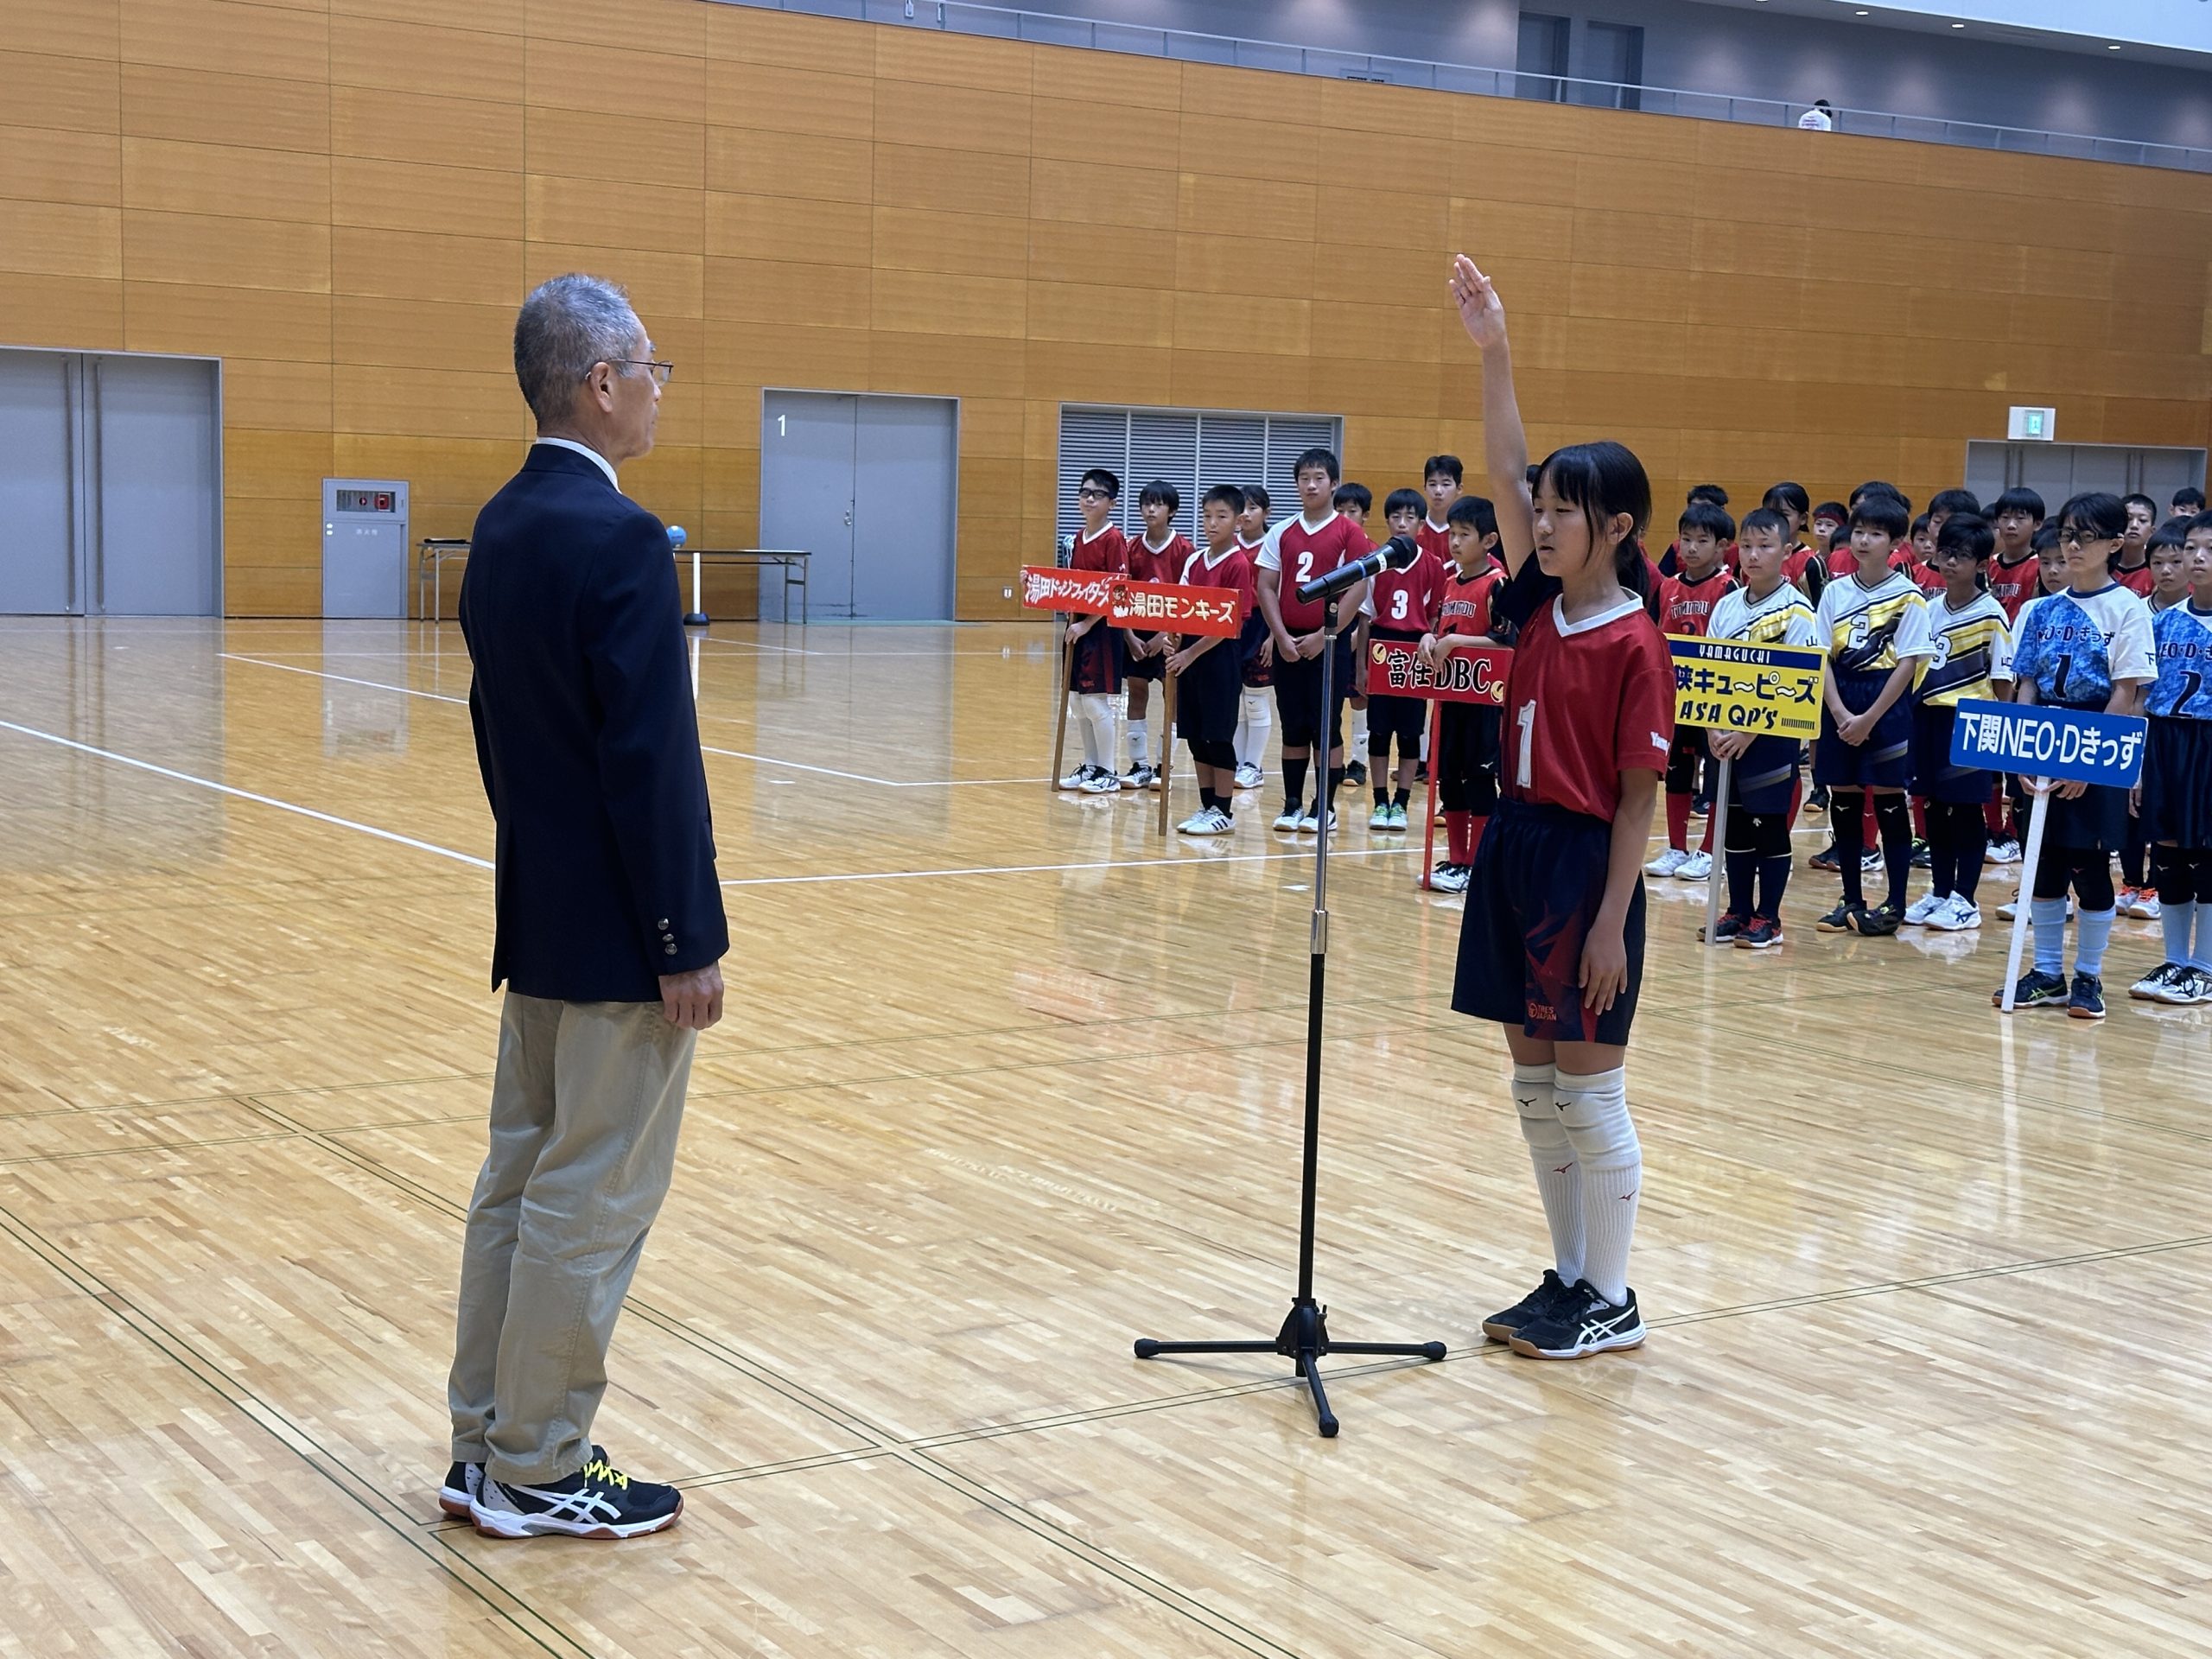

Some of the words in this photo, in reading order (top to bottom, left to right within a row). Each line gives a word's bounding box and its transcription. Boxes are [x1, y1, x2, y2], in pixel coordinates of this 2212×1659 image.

[778, 414, 785, 436] 1
[1295, 550, 1314, 582] 2
[1128, 592, 1236, 625] 湯田モンキーズ
[1391, 589, 1409, 620] 3
[1847, 613, 1870, 650] 2
[1699, 644, 1770, 664] YAMAGUCHI
[2169, 670, 2202, 718] 2
[1679, 700, 1722, 723] ASA
[1516, 698, 1537, 789] 1
